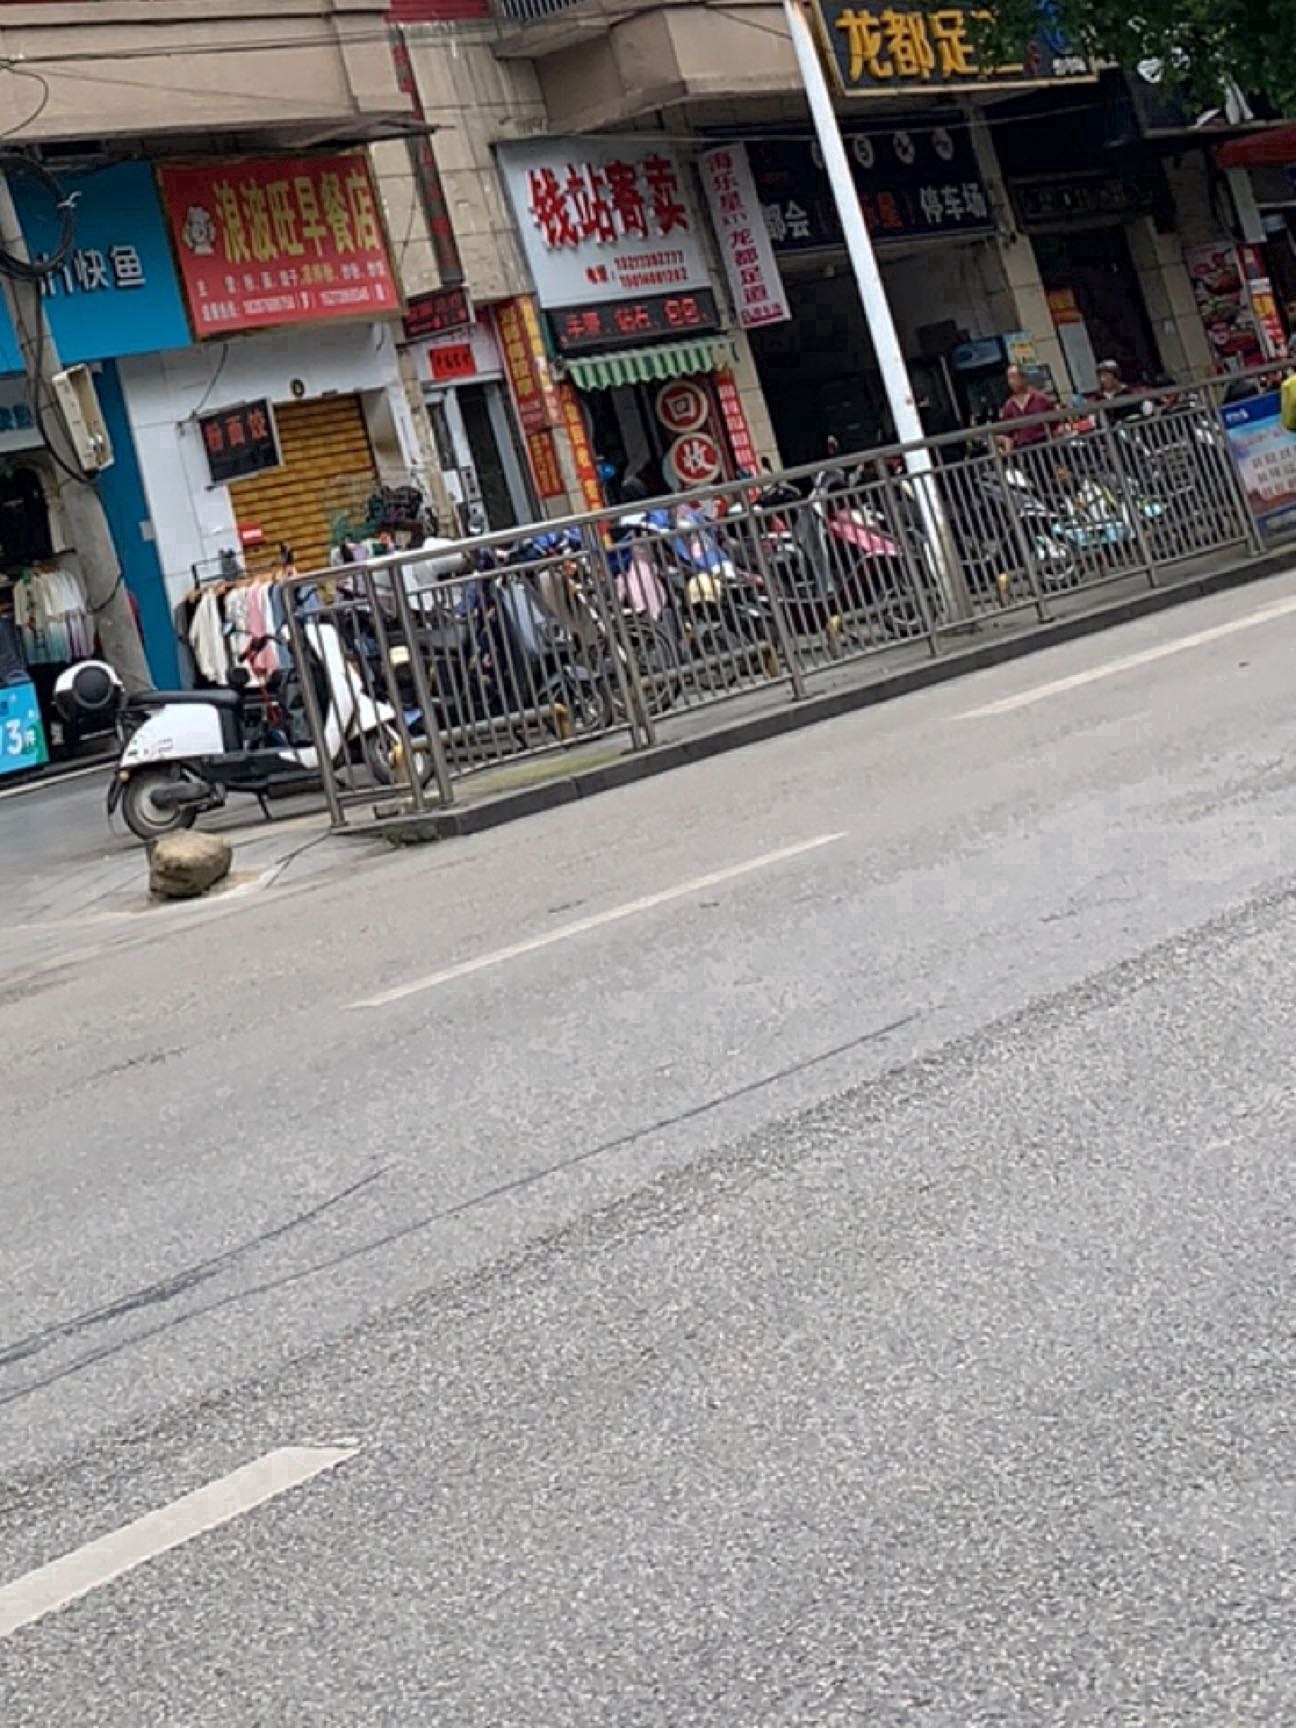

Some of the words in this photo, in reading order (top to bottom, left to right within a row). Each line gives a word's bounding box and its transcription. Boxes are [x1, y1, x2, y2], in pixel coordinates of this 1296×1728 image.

[835, 7, 1024, 83] 龙都足
[920, 182, 988, 224] 停车场
